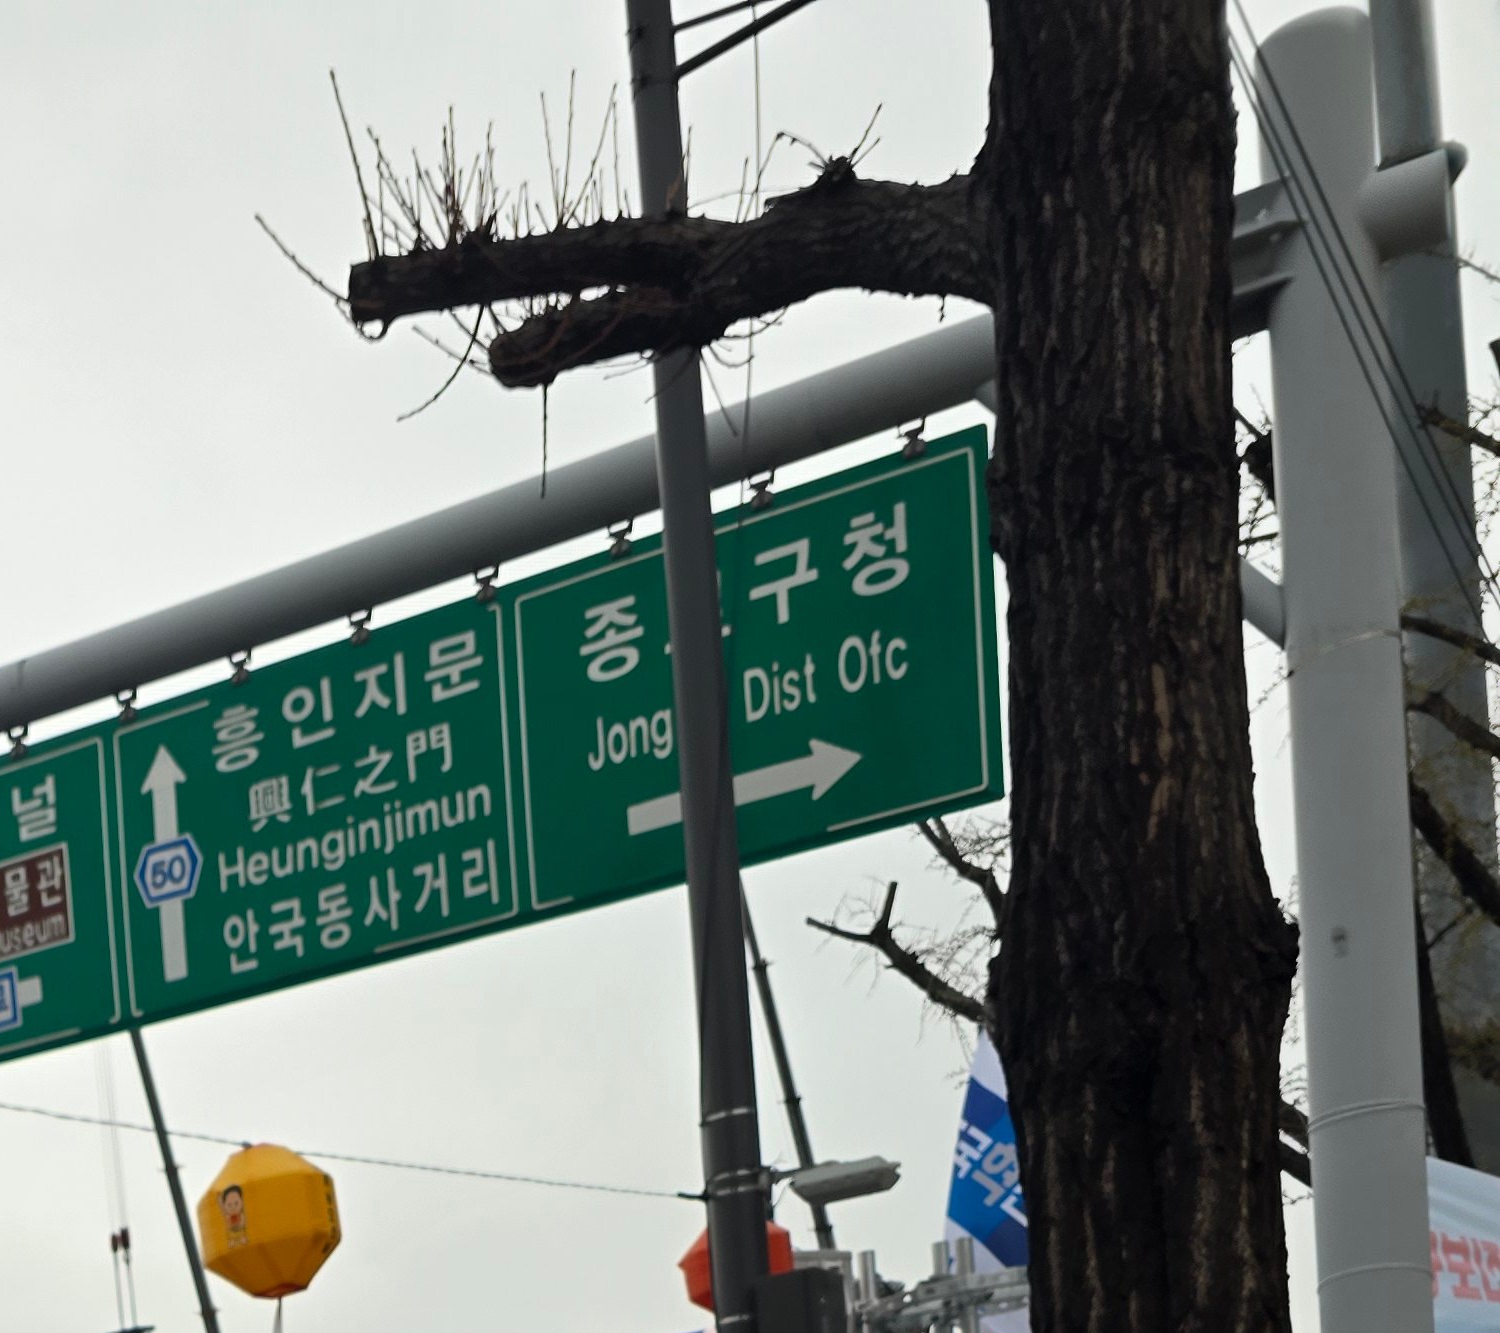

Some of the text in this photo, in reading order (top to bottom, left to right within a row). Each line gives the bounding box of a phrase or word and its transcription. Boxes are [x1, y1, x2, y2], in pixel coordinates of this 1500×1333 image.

[579, 501, 911, 684] 종구청
[211, 630, 484, 773] 흥인지문
[588, 631, 909, 772] Jong Dist Ofc
[218, 784, 492, 893] Heunginjimun
[249, 722, 453, 832] 興仁之門
[150, 855, 187, 889] 50
[223, 838, 500, 975] 안국동사거리
